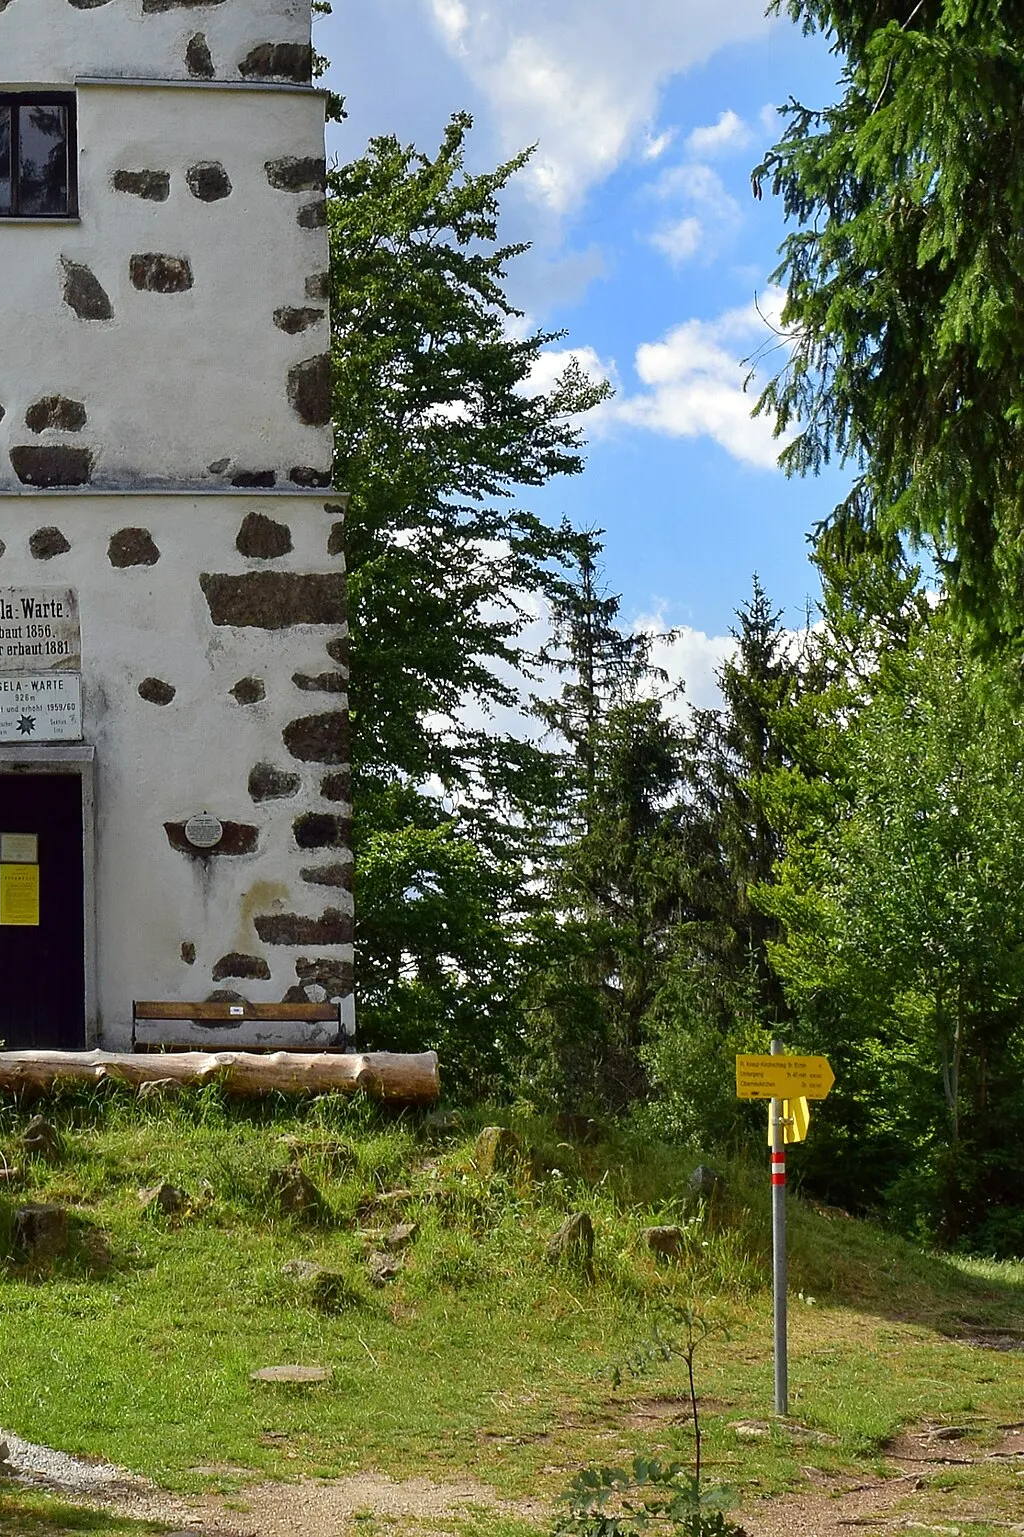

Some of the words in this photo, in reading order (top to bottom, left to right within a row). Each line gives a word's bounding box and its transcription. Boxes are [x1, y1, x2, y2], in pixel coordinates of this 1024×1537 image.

[7, 642, 42, 656] erbaut
[31, 680, 64, 690] WARTE
[47, 703, 76, 711] 1959/60
